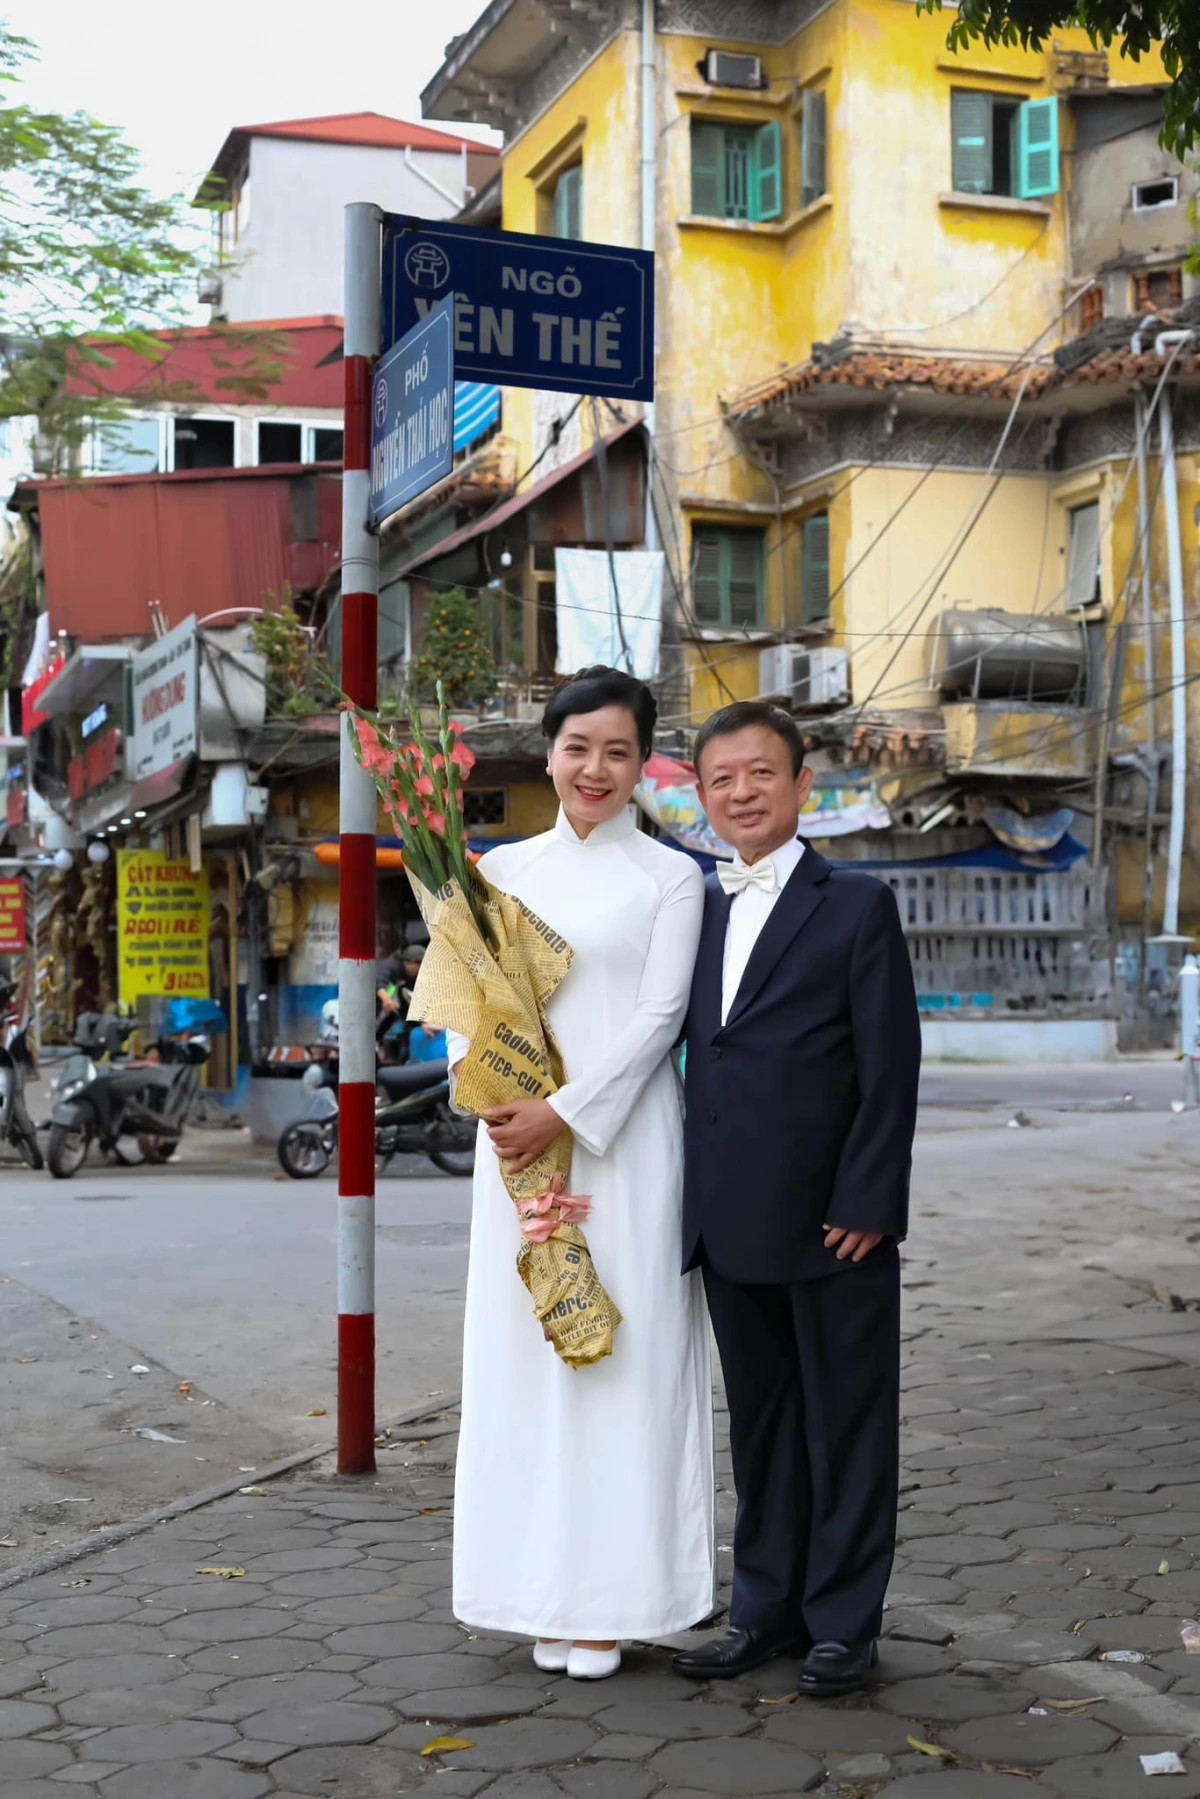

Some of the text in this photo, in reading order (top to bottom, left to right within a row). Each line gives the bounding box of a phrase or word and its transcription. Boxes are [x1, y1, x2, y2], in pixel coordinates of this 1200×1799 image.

[501, 265, 583, 298] NGÕ
[532, 306, 626, 369] THẾ
[404, 341, 429, 396] PHỐ
[407, 396, 427, 469] THÁI
[429, 387, 448, 459] HỌC
